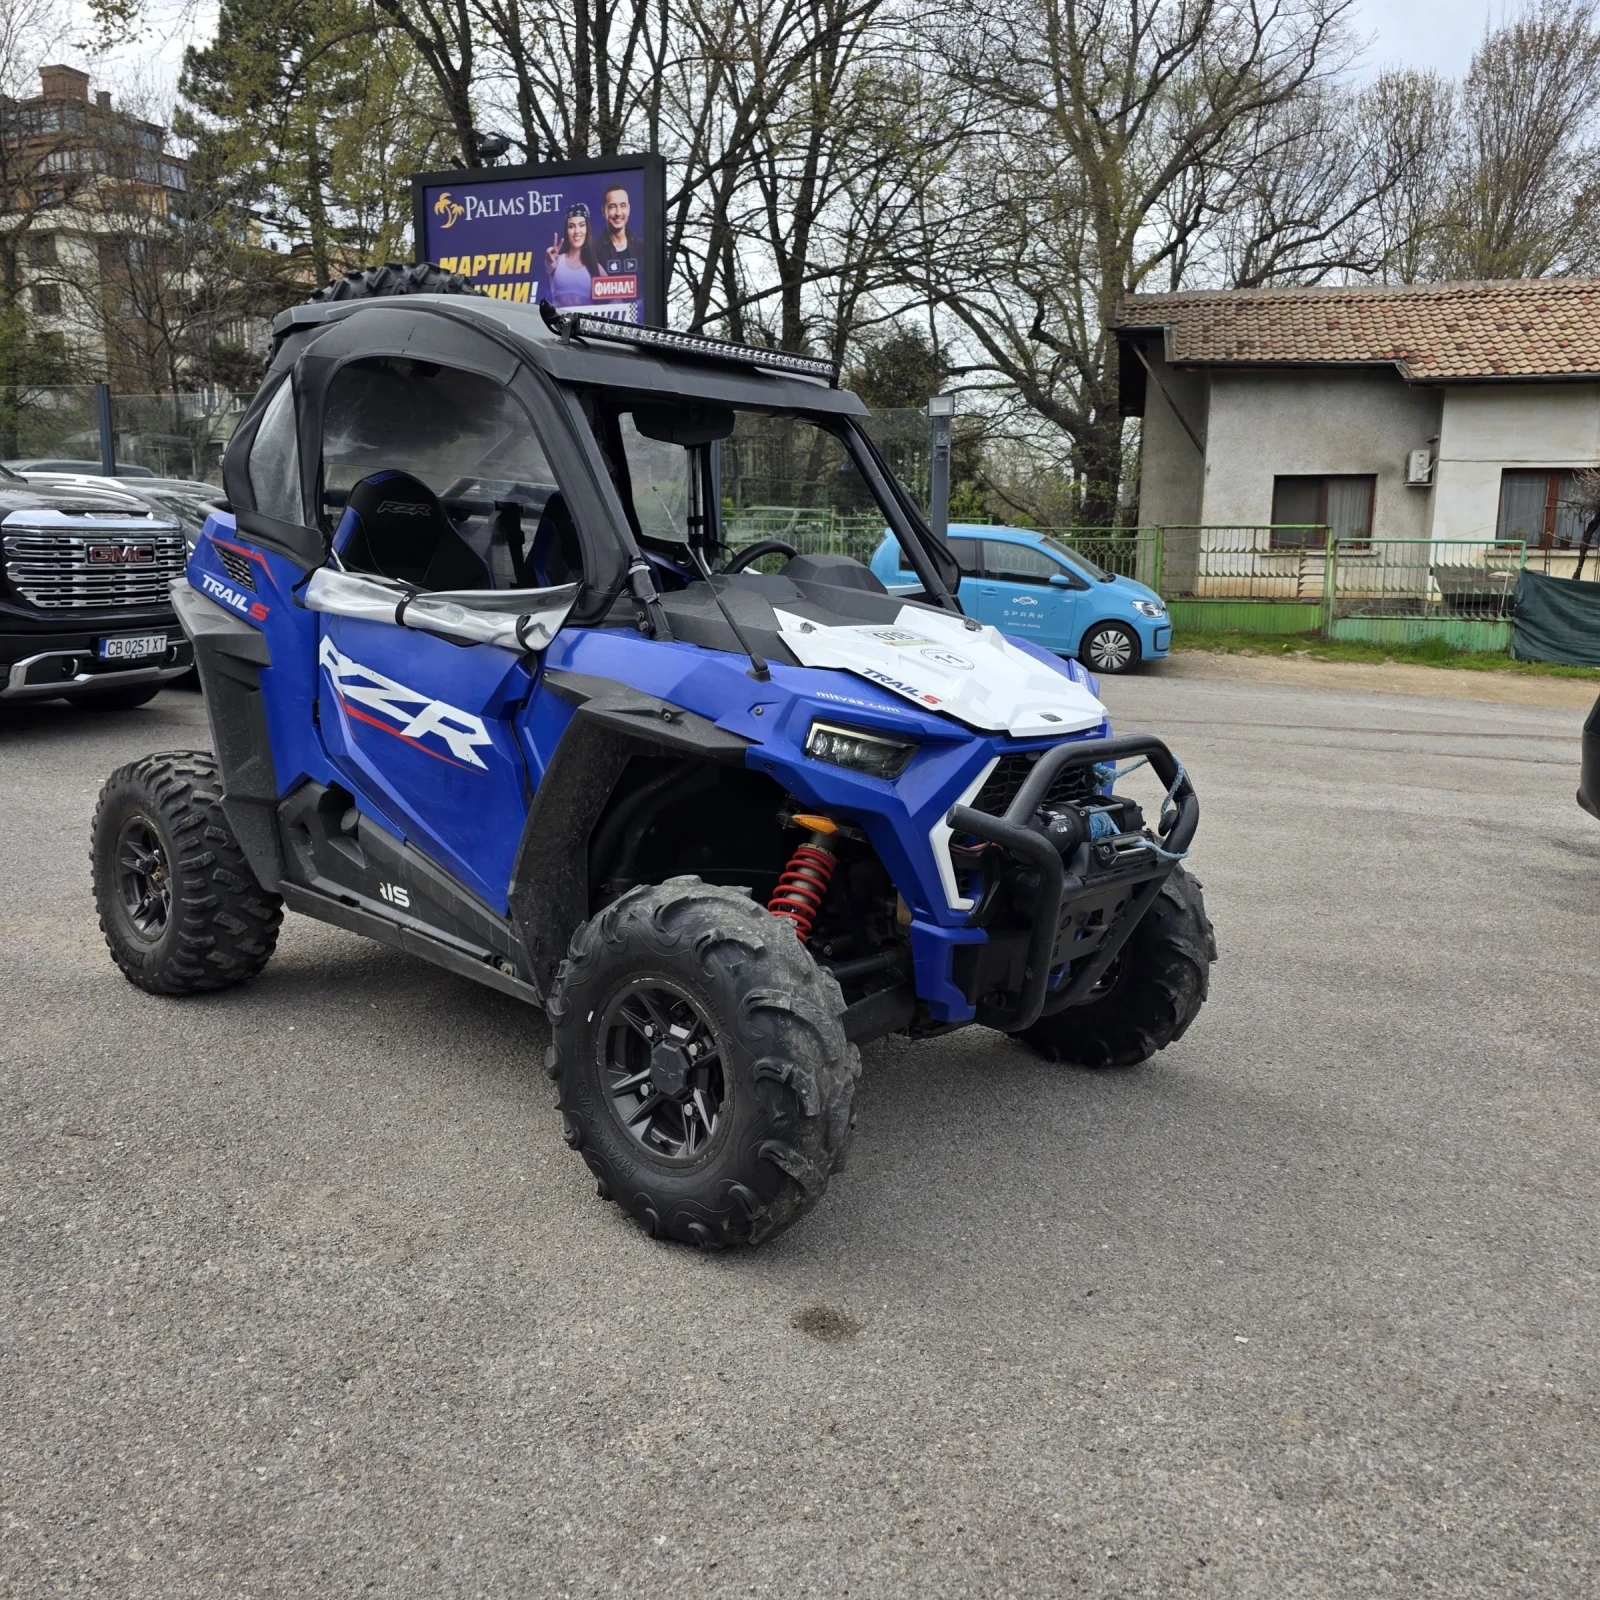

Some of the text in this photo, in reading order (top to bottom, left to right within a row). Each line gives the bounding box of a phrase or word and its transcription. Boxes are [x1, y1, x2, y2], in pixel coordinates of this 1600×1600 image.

[464, 190, 563, 221] PALMS BET
[439, 252, 533, 277] МАРТИН
[594, 281, 634, 296] ФИНАЛ!
[377, 501, 432, 517] RZR
[89, 545, 153, 563] GMC
[202, 574, 271, 622] TRAIL S
[1003, 610, 1044, 619] SPARK
[107, 637, 165, 655] CB 0251 XT
[863, 667, 942, 705] TRAIL S
[319, 634, 493, 771] RZR
[577, 1079, 638, 1179] MAXXIS
